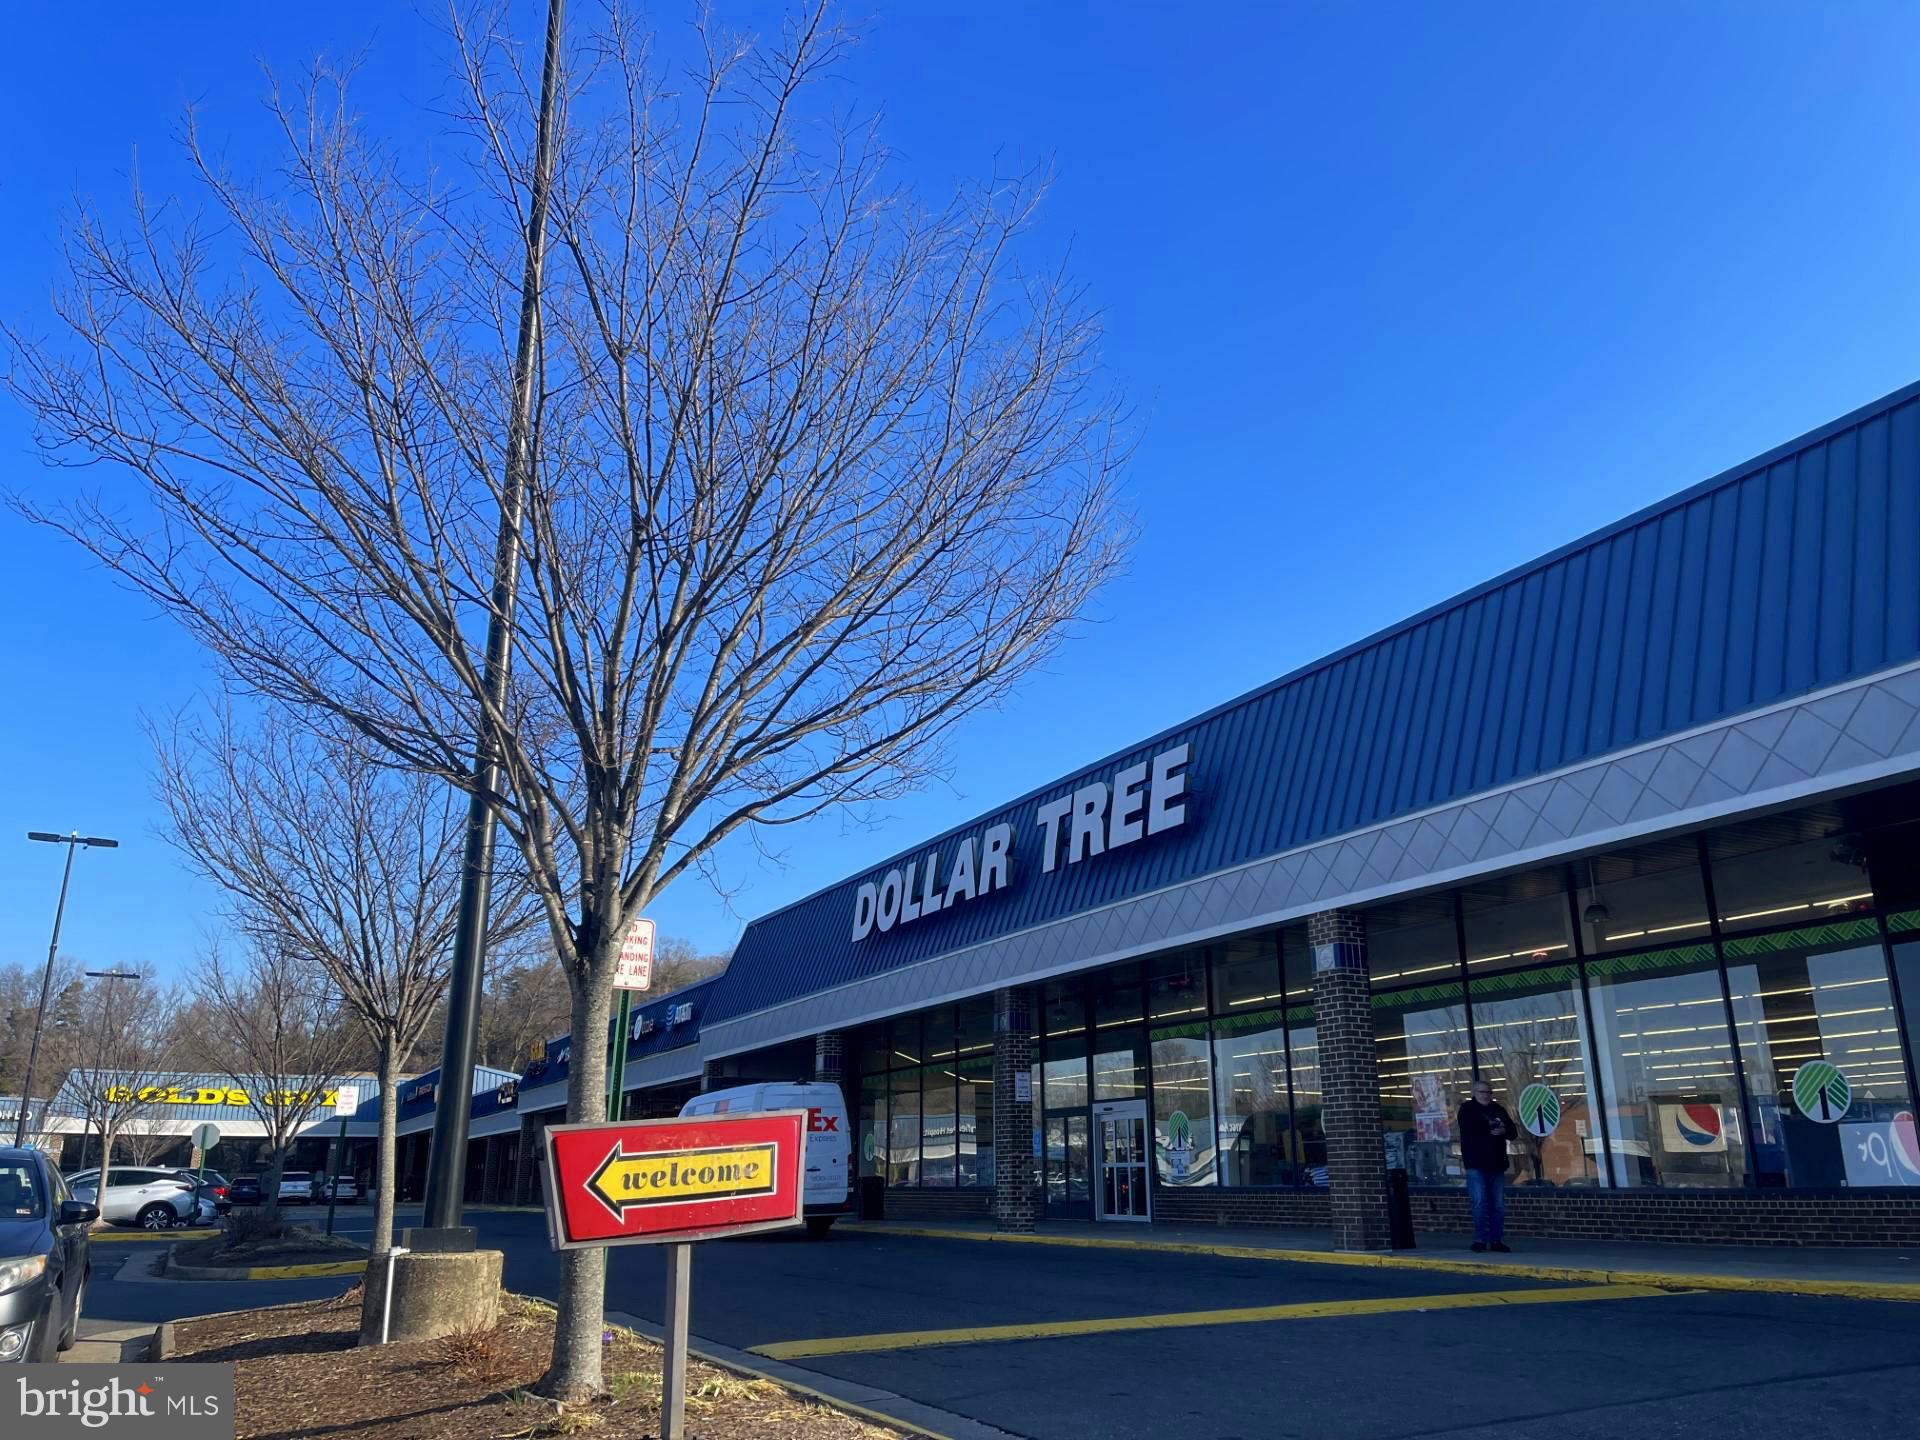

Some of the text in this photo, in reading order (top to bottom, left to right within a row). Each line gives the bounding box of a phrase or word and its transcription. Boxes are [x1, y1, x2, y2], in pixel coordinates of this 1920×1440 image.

[851, 742, 1190, 942] DOLLAR TREE
[620, 952, 648, 962] ANDING
[629, 965, 647, 977] LANE
[104, 1086, 249, 1106] GOLD'S
[622, 1161, 760, 1191] welcome
